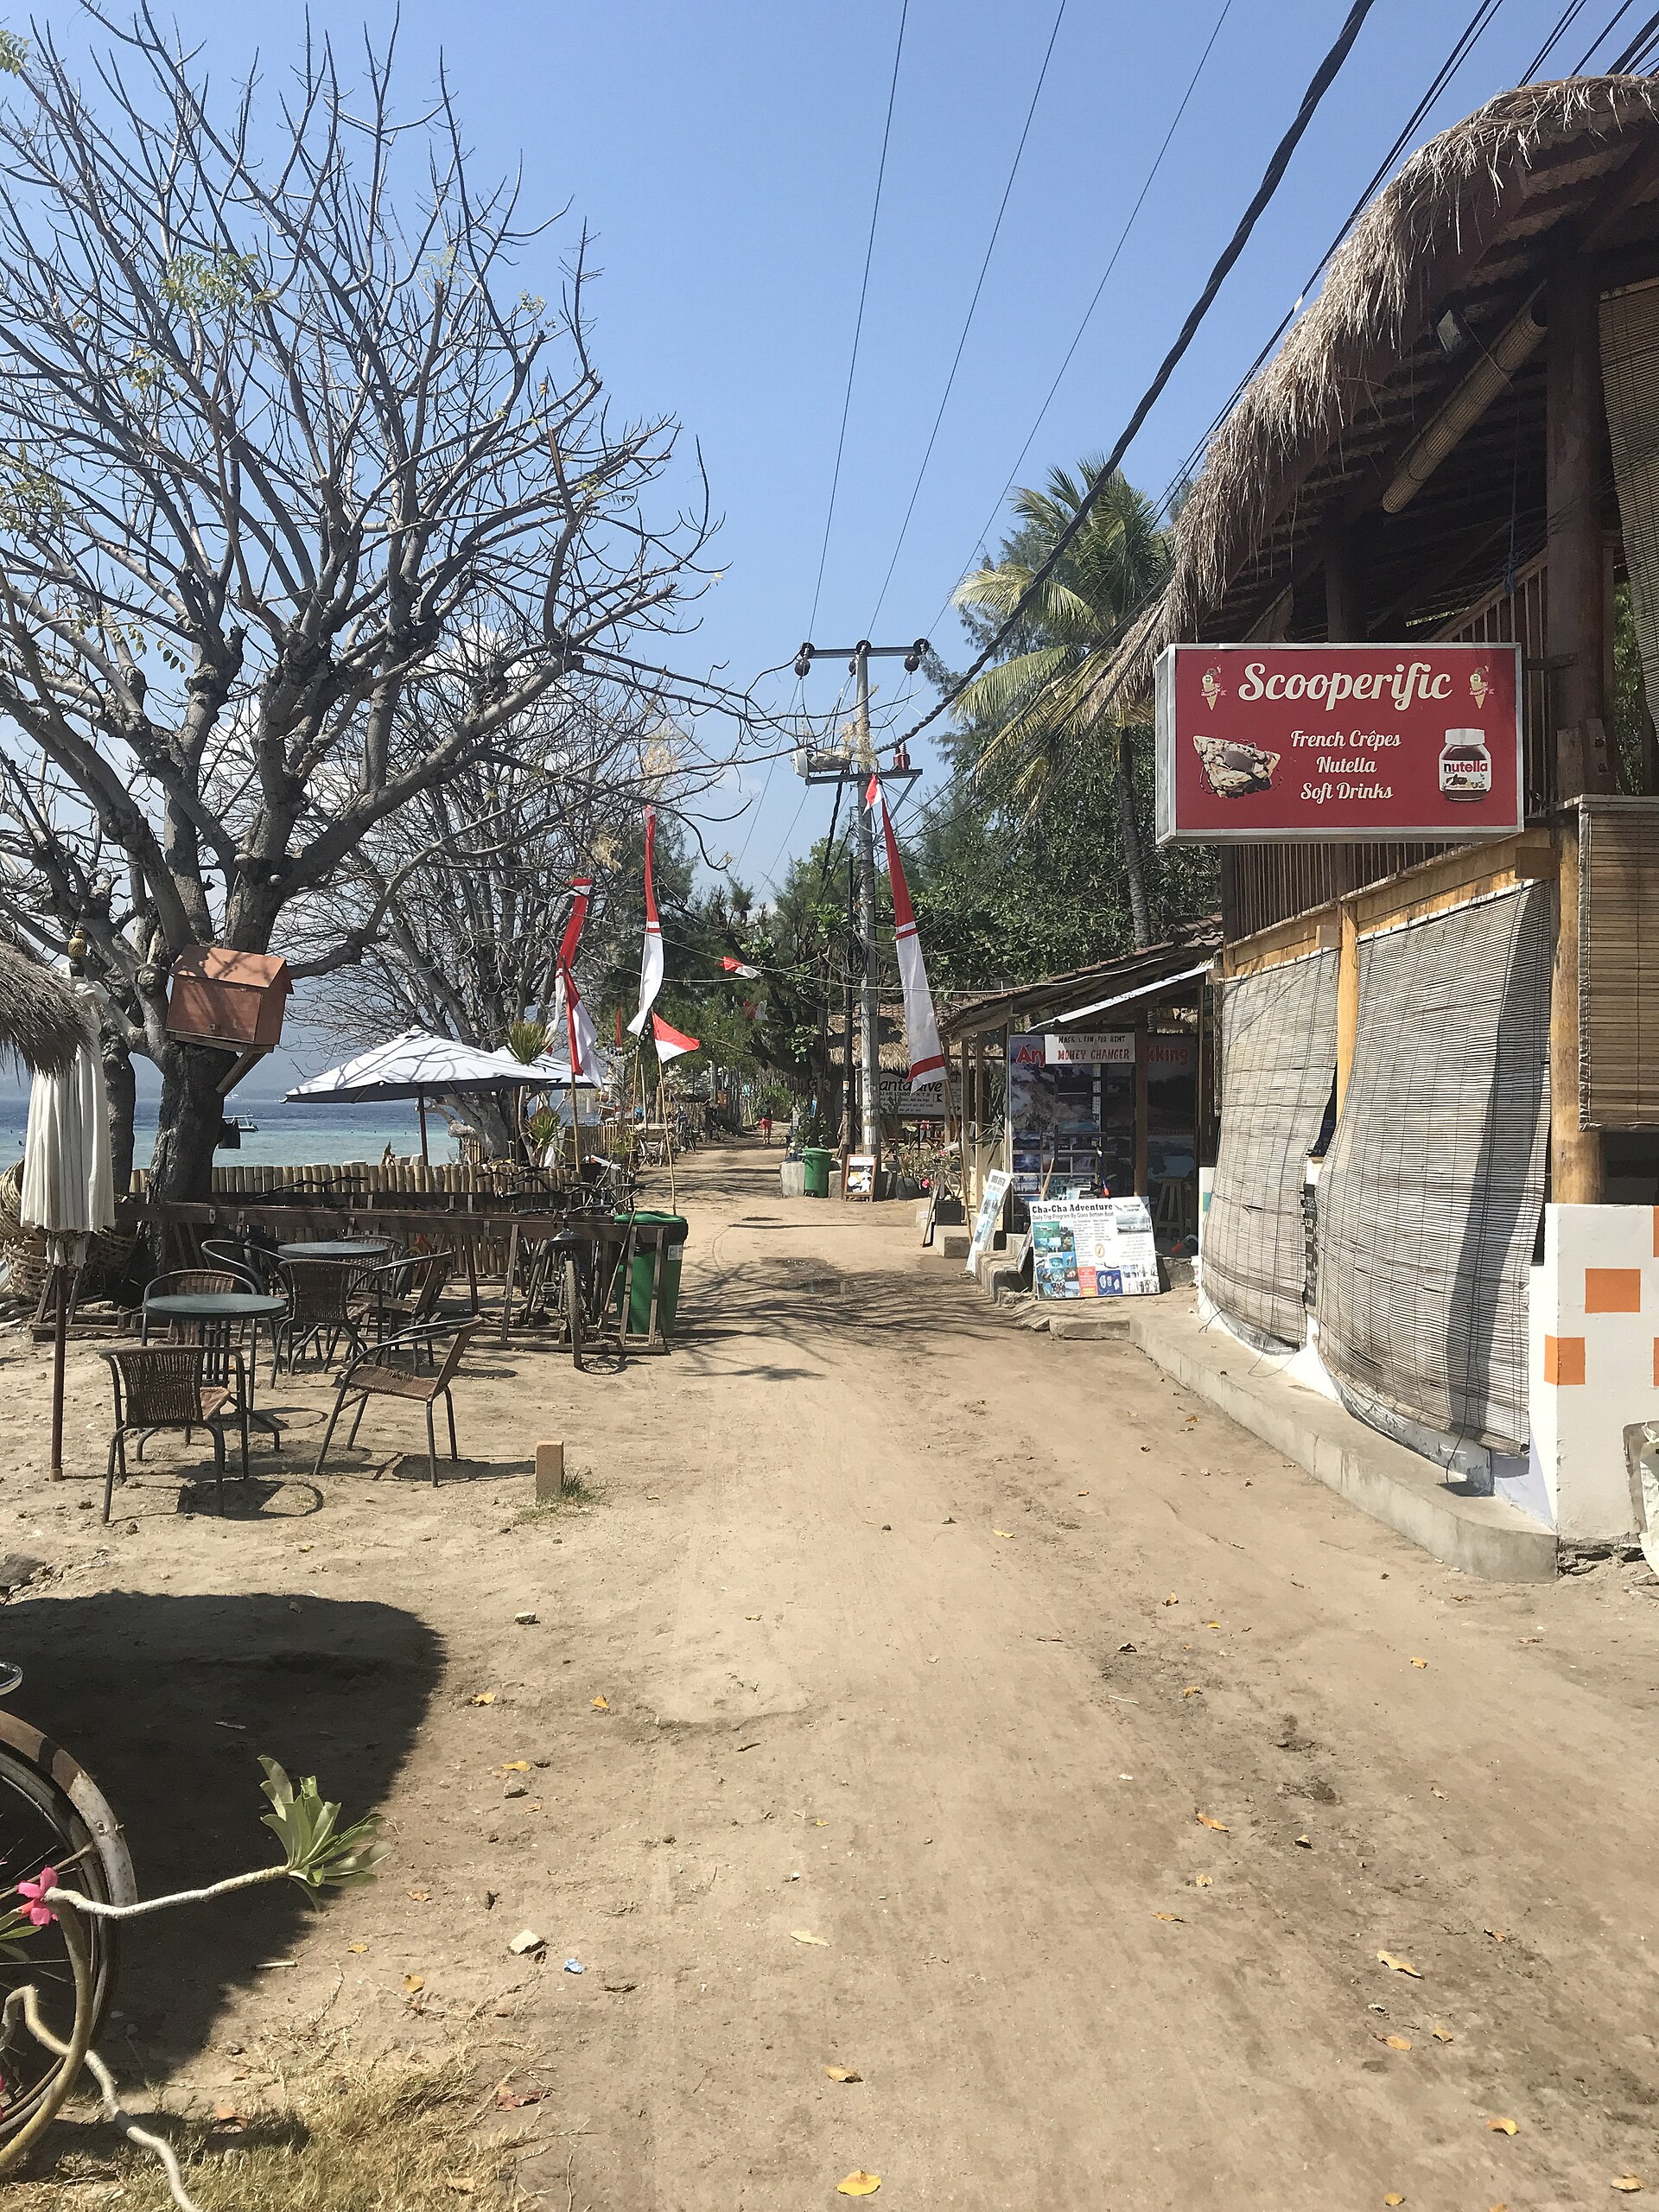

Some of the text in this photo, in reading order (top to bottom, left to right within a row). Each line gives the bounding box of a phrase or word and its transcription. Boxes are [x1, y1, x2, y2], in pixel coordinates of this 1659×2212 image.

[1238, 662, 1453, 711] Scooperific
[1290, 729, 1402, 752] French Crêpes
[1316, 756, 1377, 773] Nutella
[1443, 760, 1488, 772] nutella
[1300, 782, 1394, 804] Soft Drinks
[1057, 1048, 1130, 1060] MONEY CHANGER
[1032, 1205, 1068, 1214] Cha-Cha
